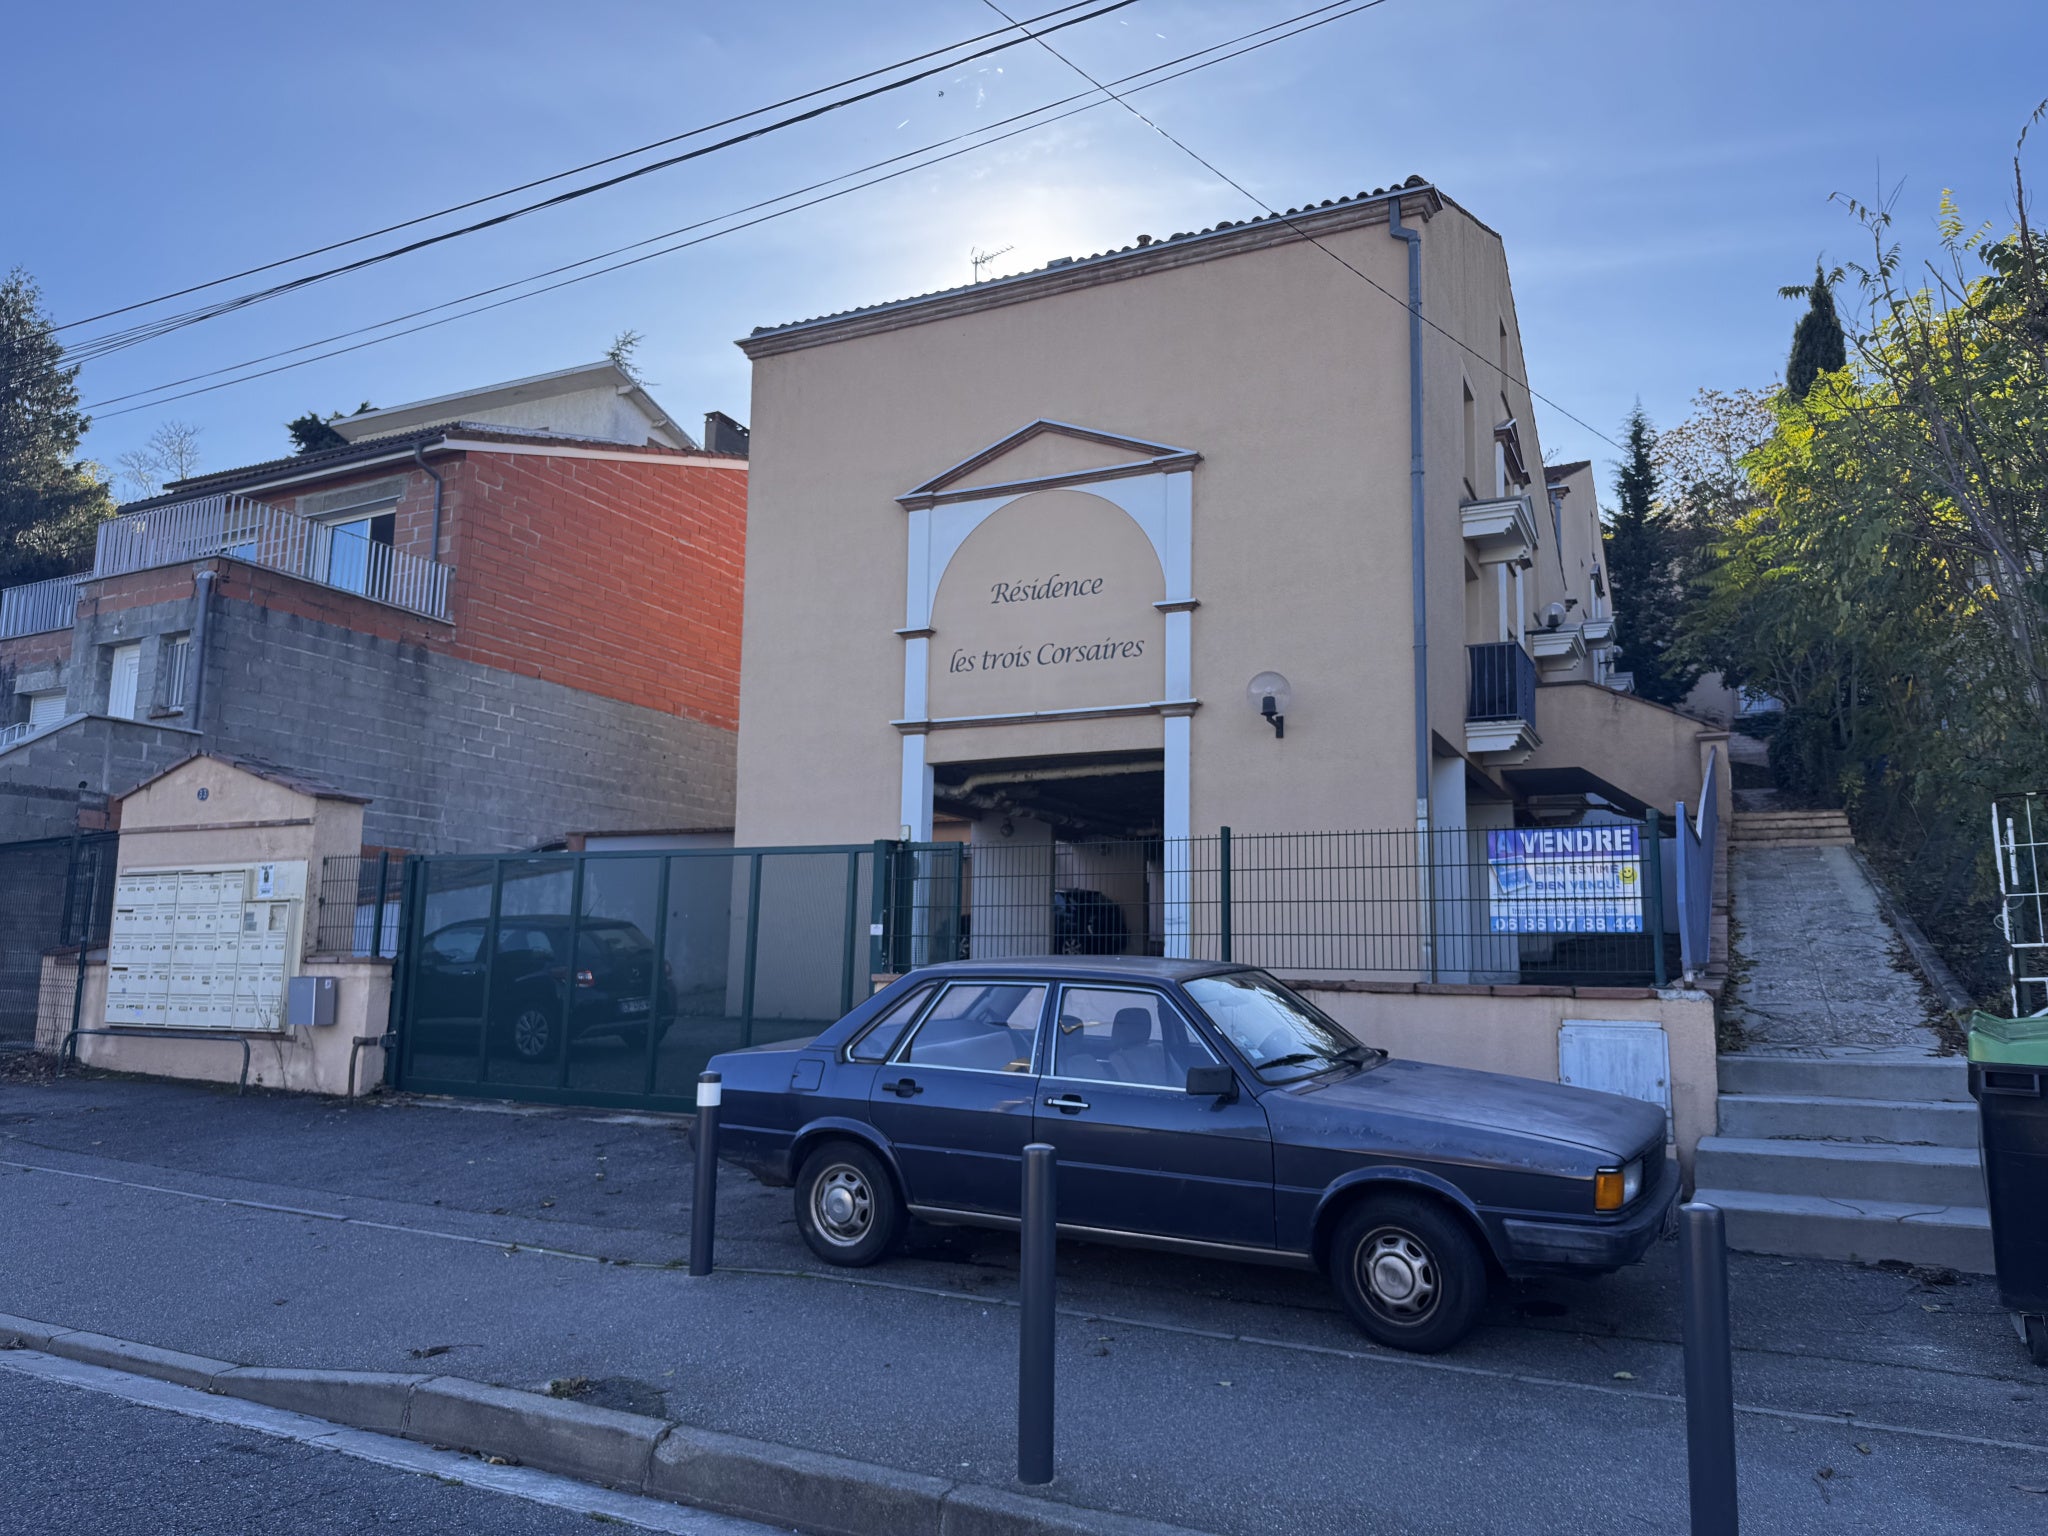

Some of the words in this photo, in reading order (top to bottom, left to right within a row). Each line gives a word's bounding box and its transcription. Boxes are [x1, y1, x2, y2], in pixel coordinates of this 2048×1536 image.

[990, 573, 1104, 605] Résidence
[949, 649, 976, 673] les
[982, 644, 1032, 670] trois
[1037, 637, 1145, 666] Corsaires
[1519, 829, 1632, 854] VENDRE
[1535, 865, 1564, 875] BIEN
[1535, 881, 1565, 890] BIEN
[1495, 918, 1518, 931] 06
[1524, 918, 1546, 930] 86
[1553, 918, 1575, 930] 07
[1583, 917, 1606, 930] 88
[1613, 917, 1636, 930] 44
